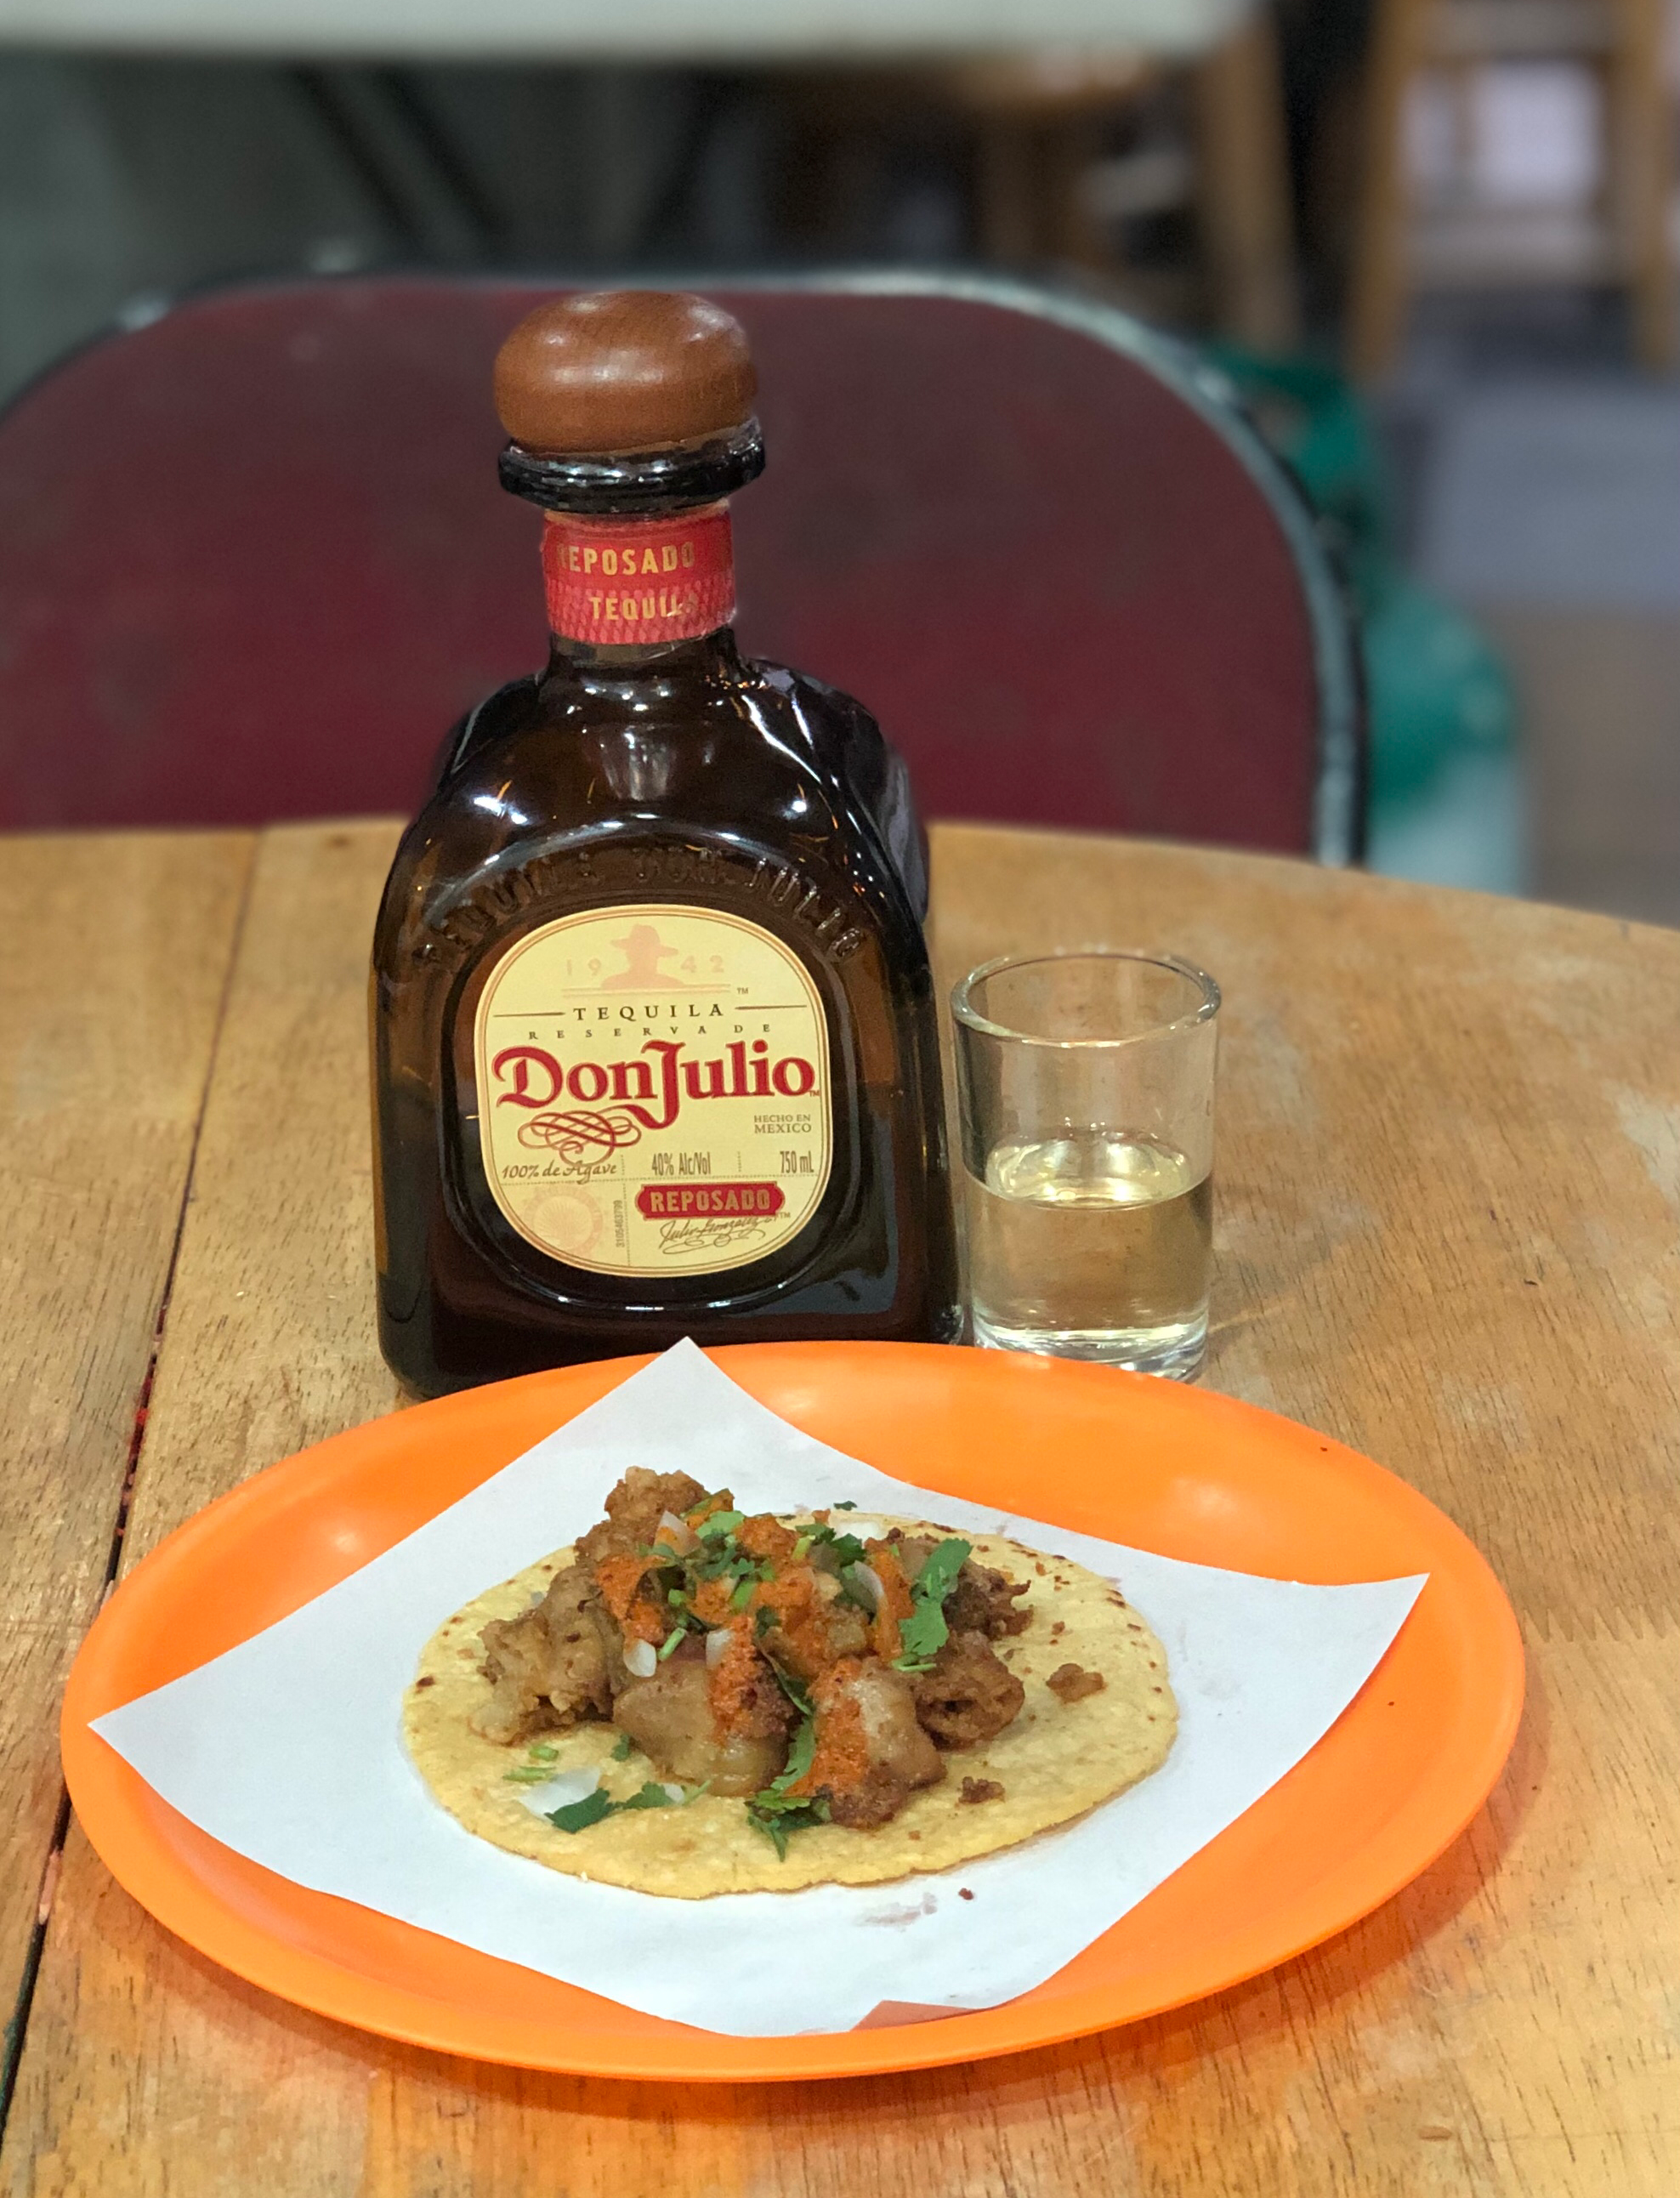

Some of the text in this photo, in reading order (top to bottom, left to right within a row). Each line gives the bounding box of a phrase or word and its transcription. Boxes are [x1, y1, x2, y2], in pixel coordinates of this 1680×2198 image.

[588, 591, 698, 620] TEQUIL
[572, 1003, 724, 1022] TEQUILA
[528, 1023, 771, 1041] RESERVA DE
[491, 1038, 816, 1129] Don Julio
[753, 1113, 812, 1124] HECHO EN
[754, 1122, 812, 1134] MEXICO
[502, 1158, 617, 1185] 100% de Agave
[651, 1151, 712, 1176] 40% Alc/Vol
[780, 1150, 814, 1174] 750 mL
[650, 1189, 770, 1213] REPOSADO
